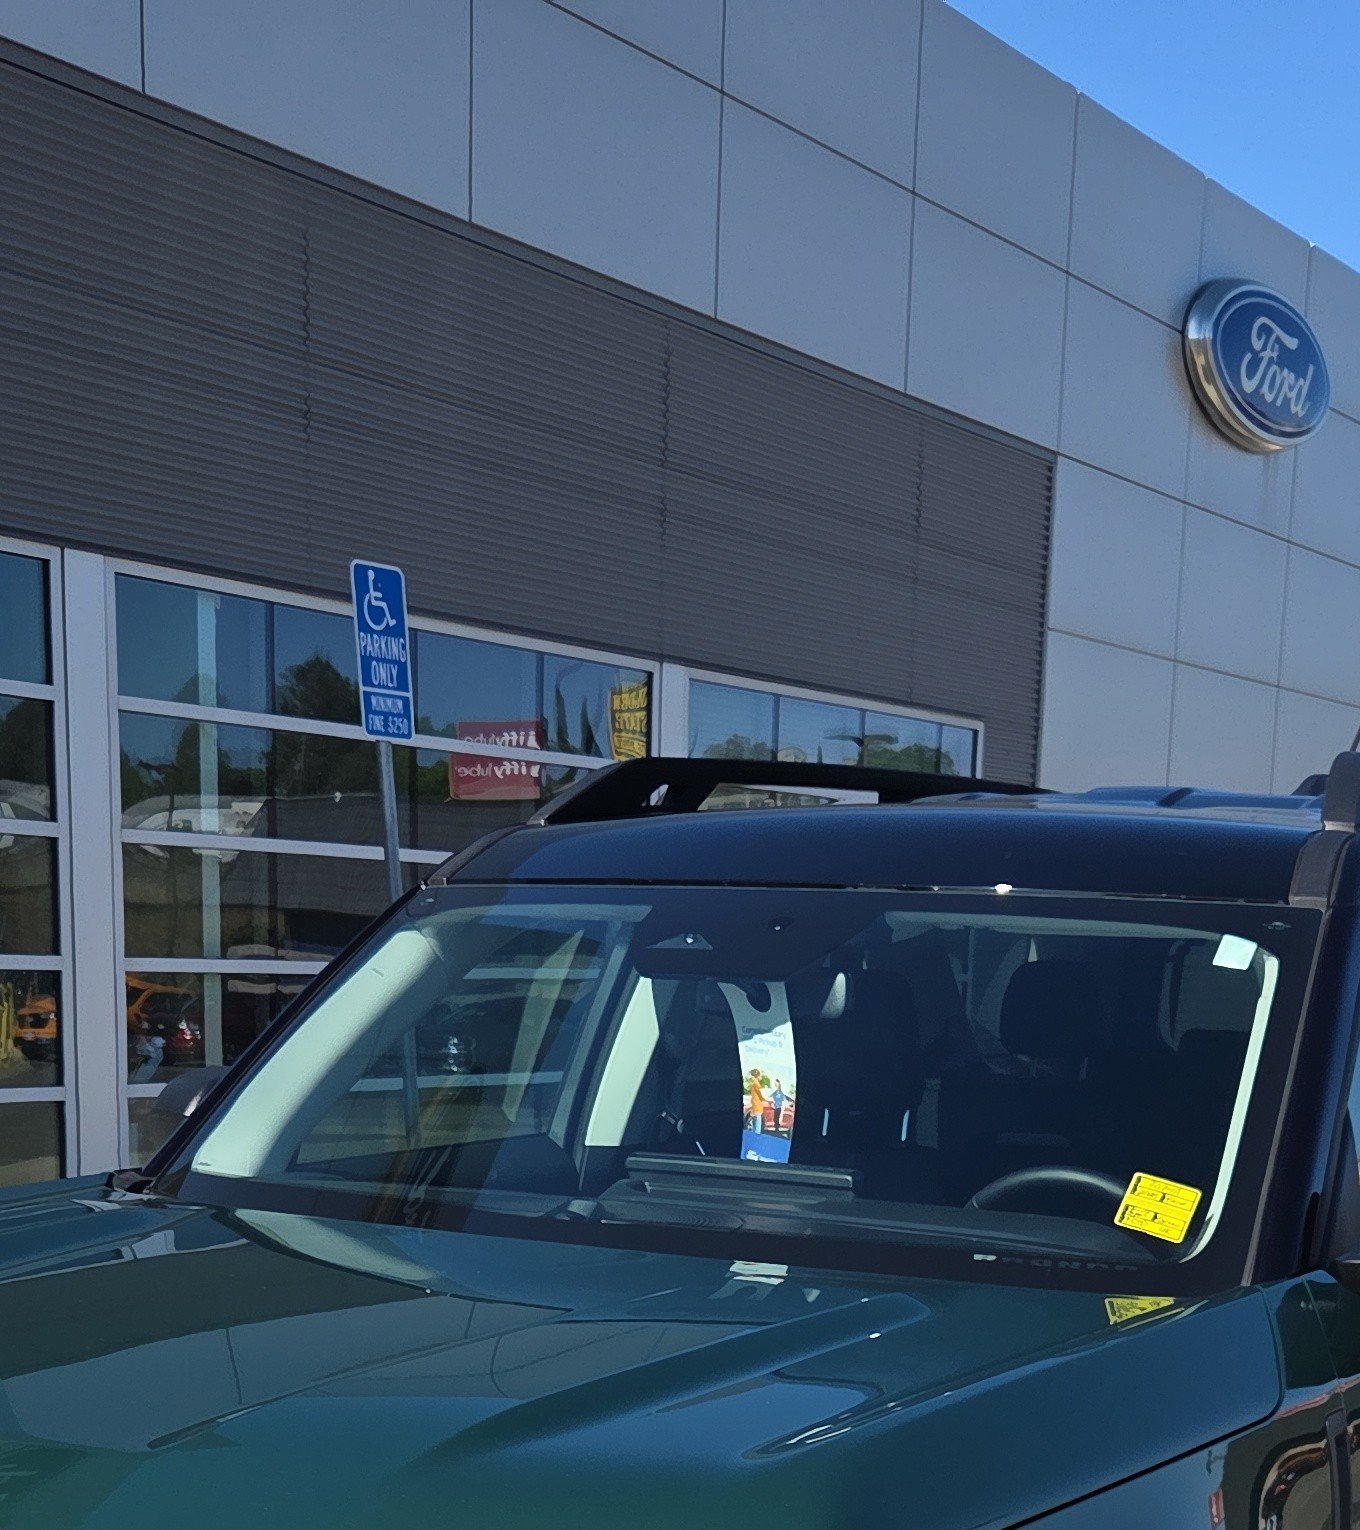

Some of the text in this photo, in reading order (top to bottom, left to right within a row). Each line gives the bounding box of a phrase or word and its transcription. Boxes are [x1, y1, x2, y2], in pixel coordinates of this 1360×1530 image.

[1240, 316, 1315, 418] Ford
[360, 631, 407, 663] PARKING
[371, 660, 398, 688] ONLY
[371, 694, 404, 714] MINIMUM
[368, 713, 409, 735] FINE $250
